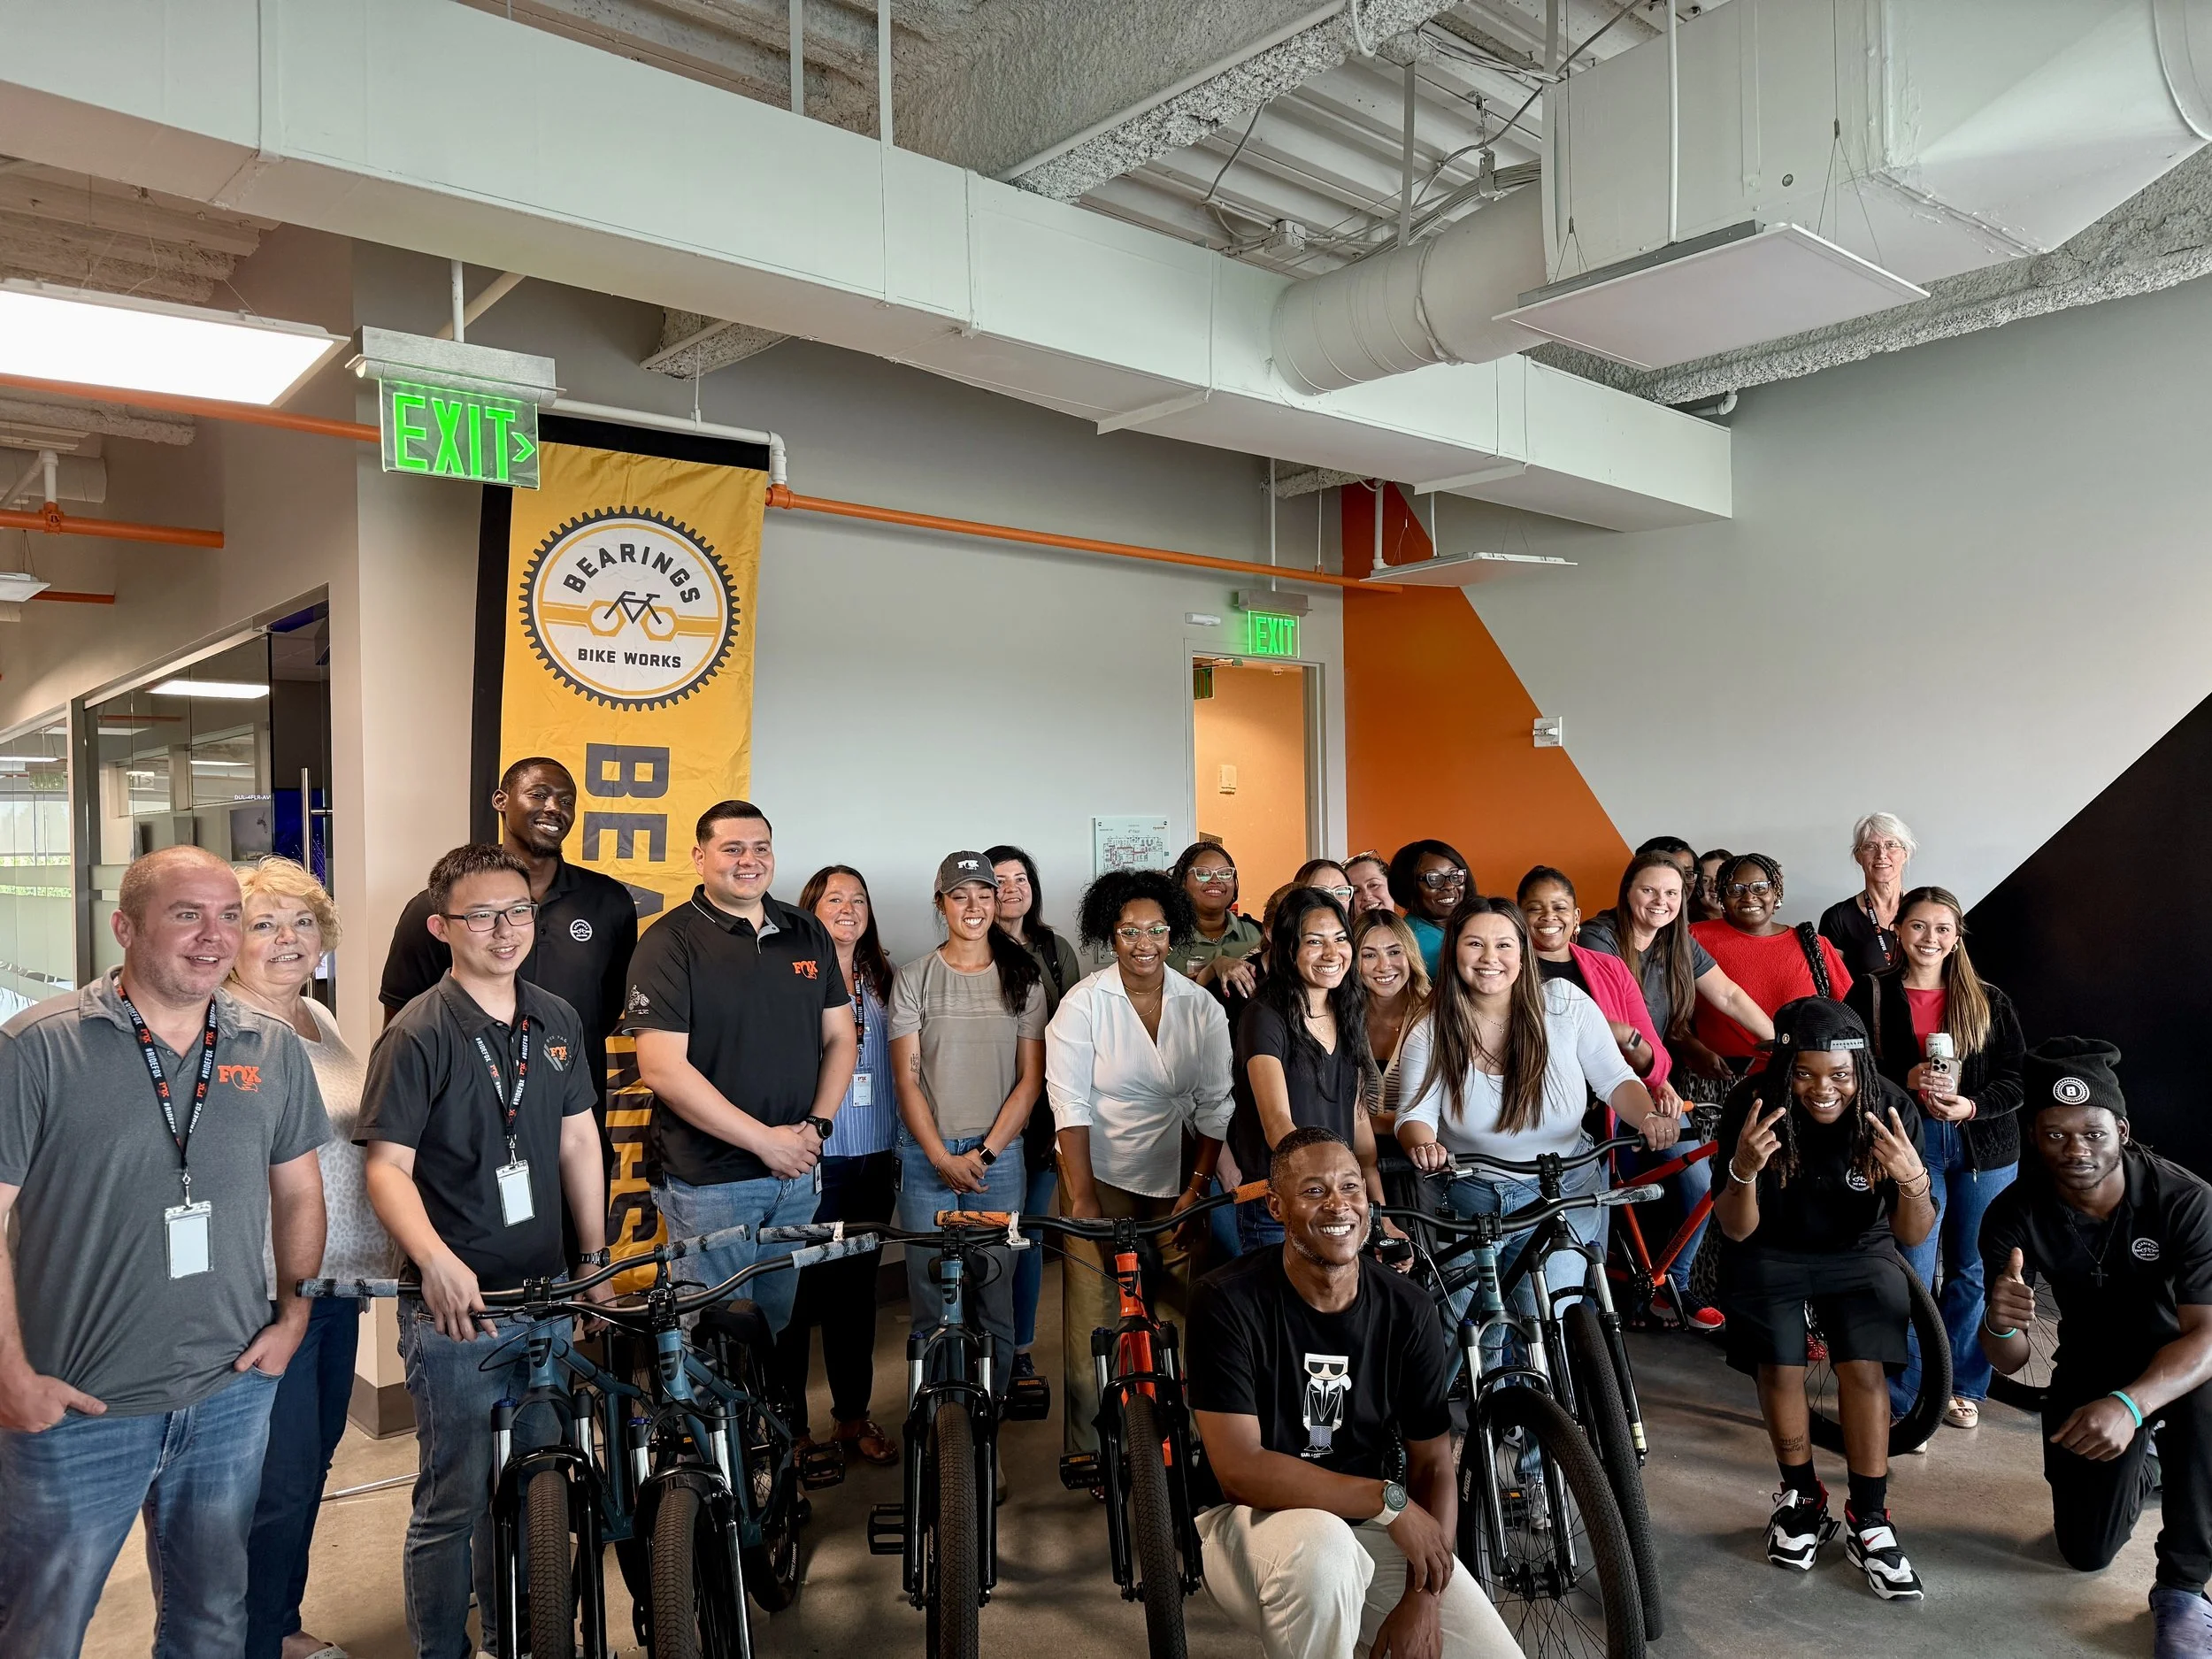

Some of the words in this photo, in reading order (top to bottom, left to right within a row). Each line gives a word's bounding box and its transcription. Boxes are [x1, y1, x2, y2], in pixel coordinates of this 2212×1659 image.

[393, 392, 515, 481] EXIT
[563, 543, 701, 603] BEARINGS
[1256, 616, 1294, 656] EXIT
[578, 648, 616, 664] BIKE
[624, 651, 681, 668] WORKS
[1195, 668, 1211, 698] IT
[957, 860, 979, 870] FOX
[792, 960, 818, 979] FOX
[144, 1048, 163, 1079] #RIDEFOX
[202, 1049, 214, 1079] #RIDEFOX
[475, 1037, 492, 1063] #RIDEFOX
[217, 1064, 263, 1092] FOX
[2065, 1086, 2077, 1096] B
[512, 1079, 526, 1106] #RIDEFOX
